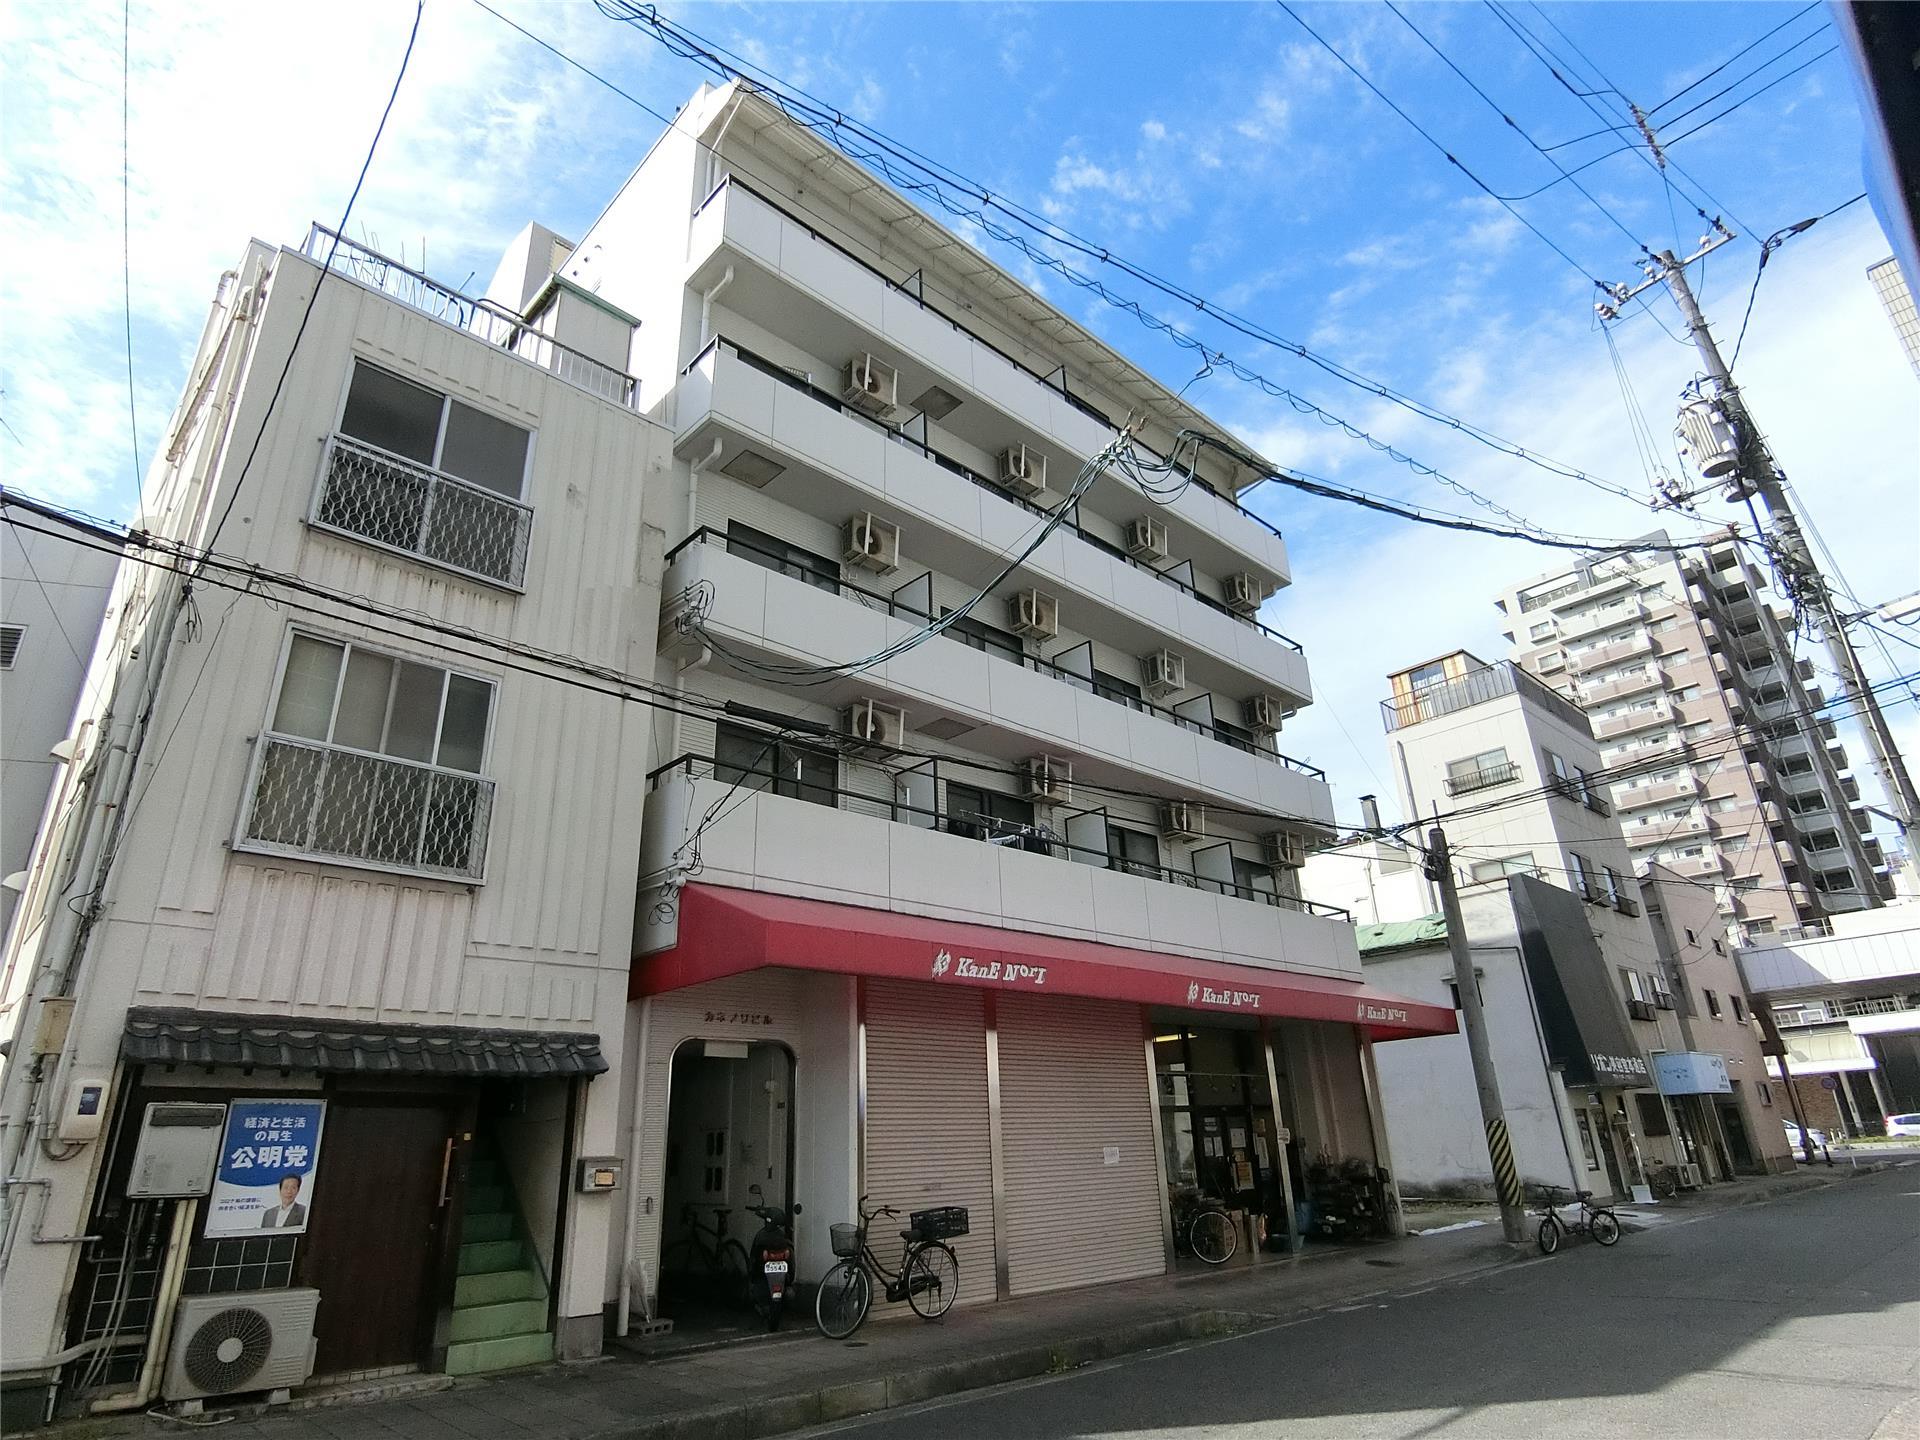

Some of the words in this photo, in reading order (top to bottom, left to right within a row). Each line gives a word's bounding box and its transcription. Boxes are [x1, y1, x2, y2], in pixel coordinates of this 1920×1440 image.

[704, 1011, 774, 1025] カネノリビル
[244, 1117, 306, 1128] 経済と生活
[254, 1130, 293, 1142] の再生
[231, 1145, 308, 1168] 公明党
